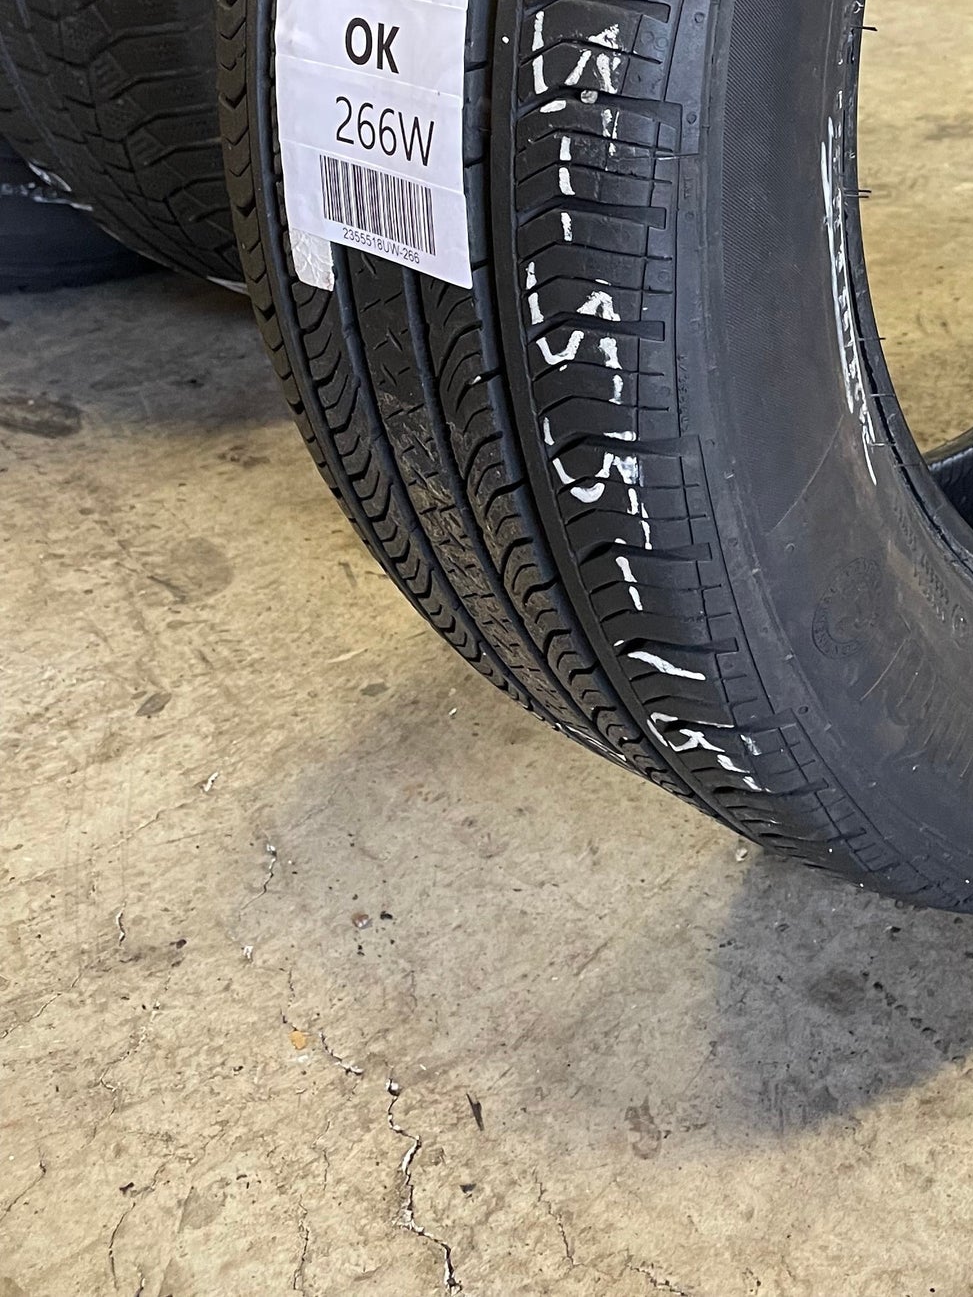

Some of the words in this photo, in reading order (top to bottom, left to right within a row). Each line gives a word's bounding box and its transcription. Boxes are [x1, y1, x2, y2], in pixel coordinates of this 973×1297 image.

[344, 17, 401, 75] OK
[335, 95, 435, 168] 266W
[342, 227, 421, 264] 2355518UW-266
